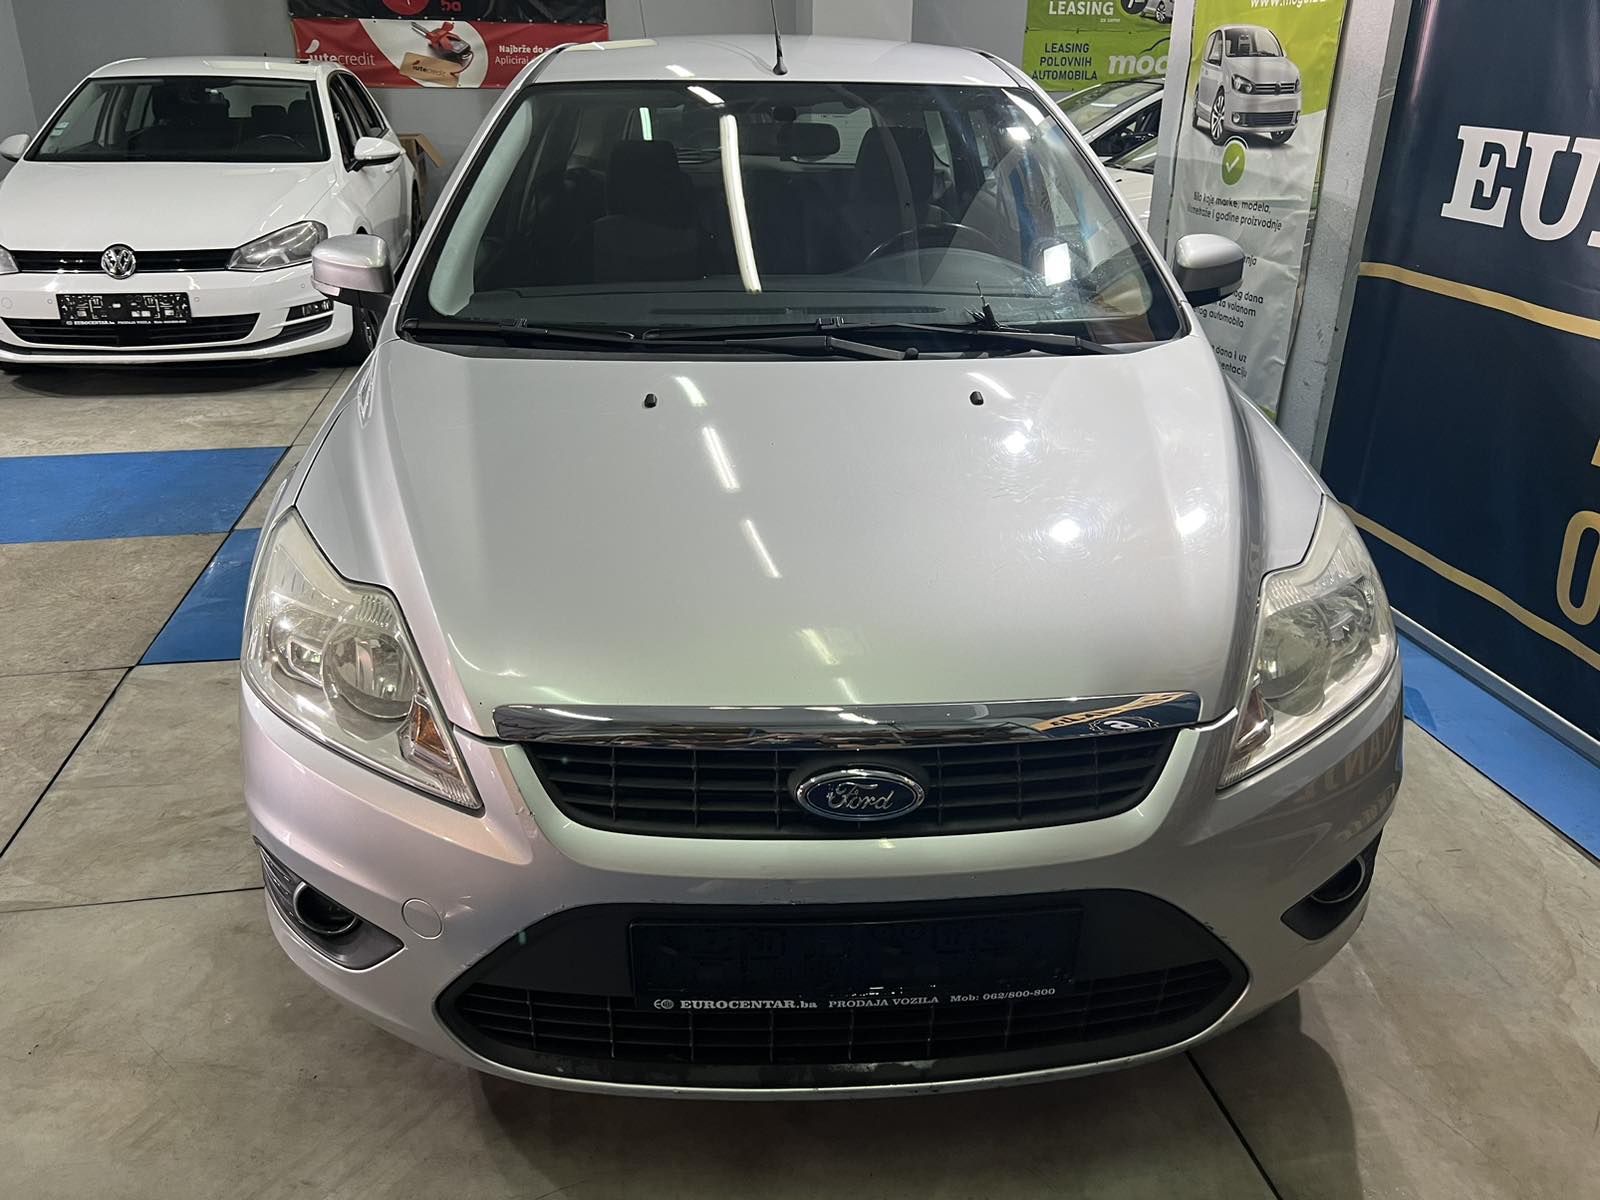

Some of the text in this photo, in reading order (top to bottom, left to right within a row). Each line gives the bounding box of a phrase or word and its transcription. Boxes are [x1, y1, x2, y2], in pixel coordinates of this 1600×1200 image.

[1048, 1, 1114, 16] LEASING
[532, 45, 543, 53] do
[1044, 43, 1090, 54] LEASING
[1039, 56, 1092, 67] POLOVNIH
[1032, 70, 1098, 81] AUTOMOBILA
[1440, 125, 1600, 247] EU
[1241, 201, 1271, 214] modela,
[1240, 216, 1282, 232] proizvodnje
[1244, 291, 1264, 304] dana
[827, 781, 895, 810] Ford
[680, 988, 1056, 1010] EUROCENTAR.ba PRODAJA VOZILA Mob: 062/800-800
